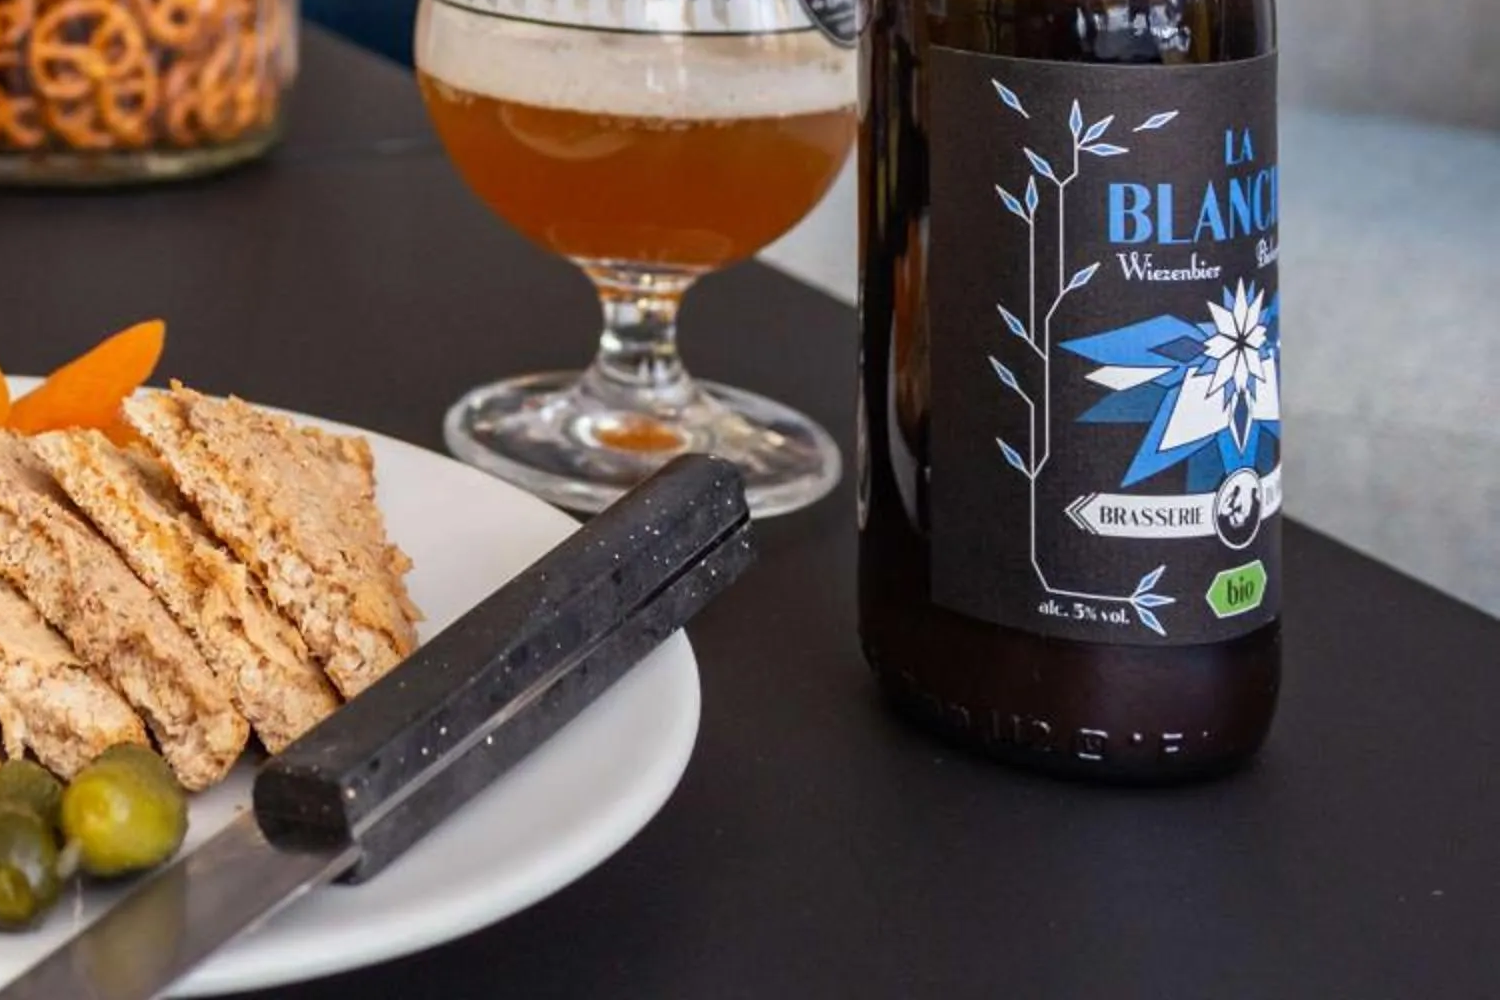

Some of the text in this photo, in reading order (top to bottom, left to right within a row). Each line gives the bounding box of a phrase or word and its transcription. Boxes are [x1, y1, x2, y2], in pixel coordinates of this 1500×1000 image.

[1225, 128, 1253, 165] LA
[1100, 506, 1204, 527] BRASSERIE
[1227, 576, 1255, 606] bio
[1039, 600, 1130, 625] alc. 5% vol.
